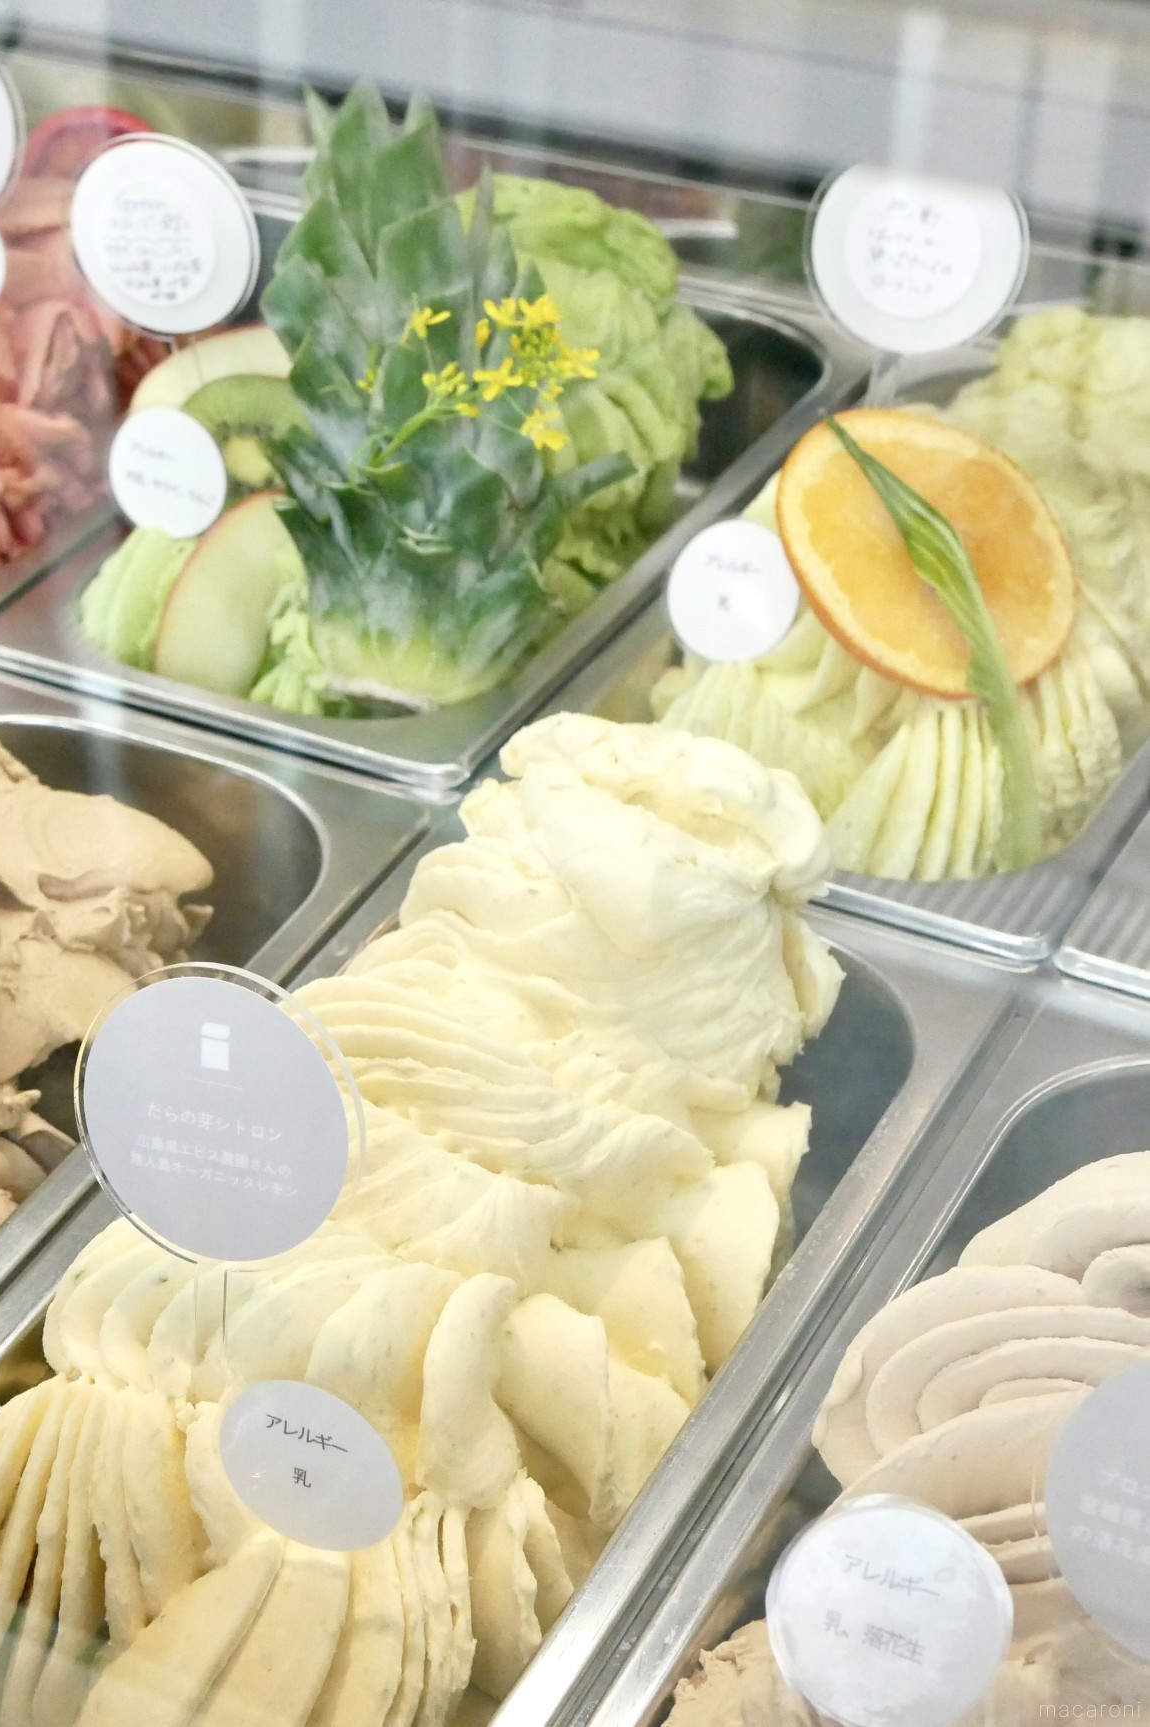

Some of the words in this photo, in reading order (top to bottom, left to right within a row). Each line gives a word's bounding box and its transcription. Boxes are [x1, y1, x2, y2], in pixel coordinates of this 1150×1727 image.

[146, 1102, 282, 1141] たらの芽シトロン
[265, 1413, 348, 1452] アレルギー
[293, 1467, 311, 1488] 乳
[842, 1553, 940, 1597] アレルギー
